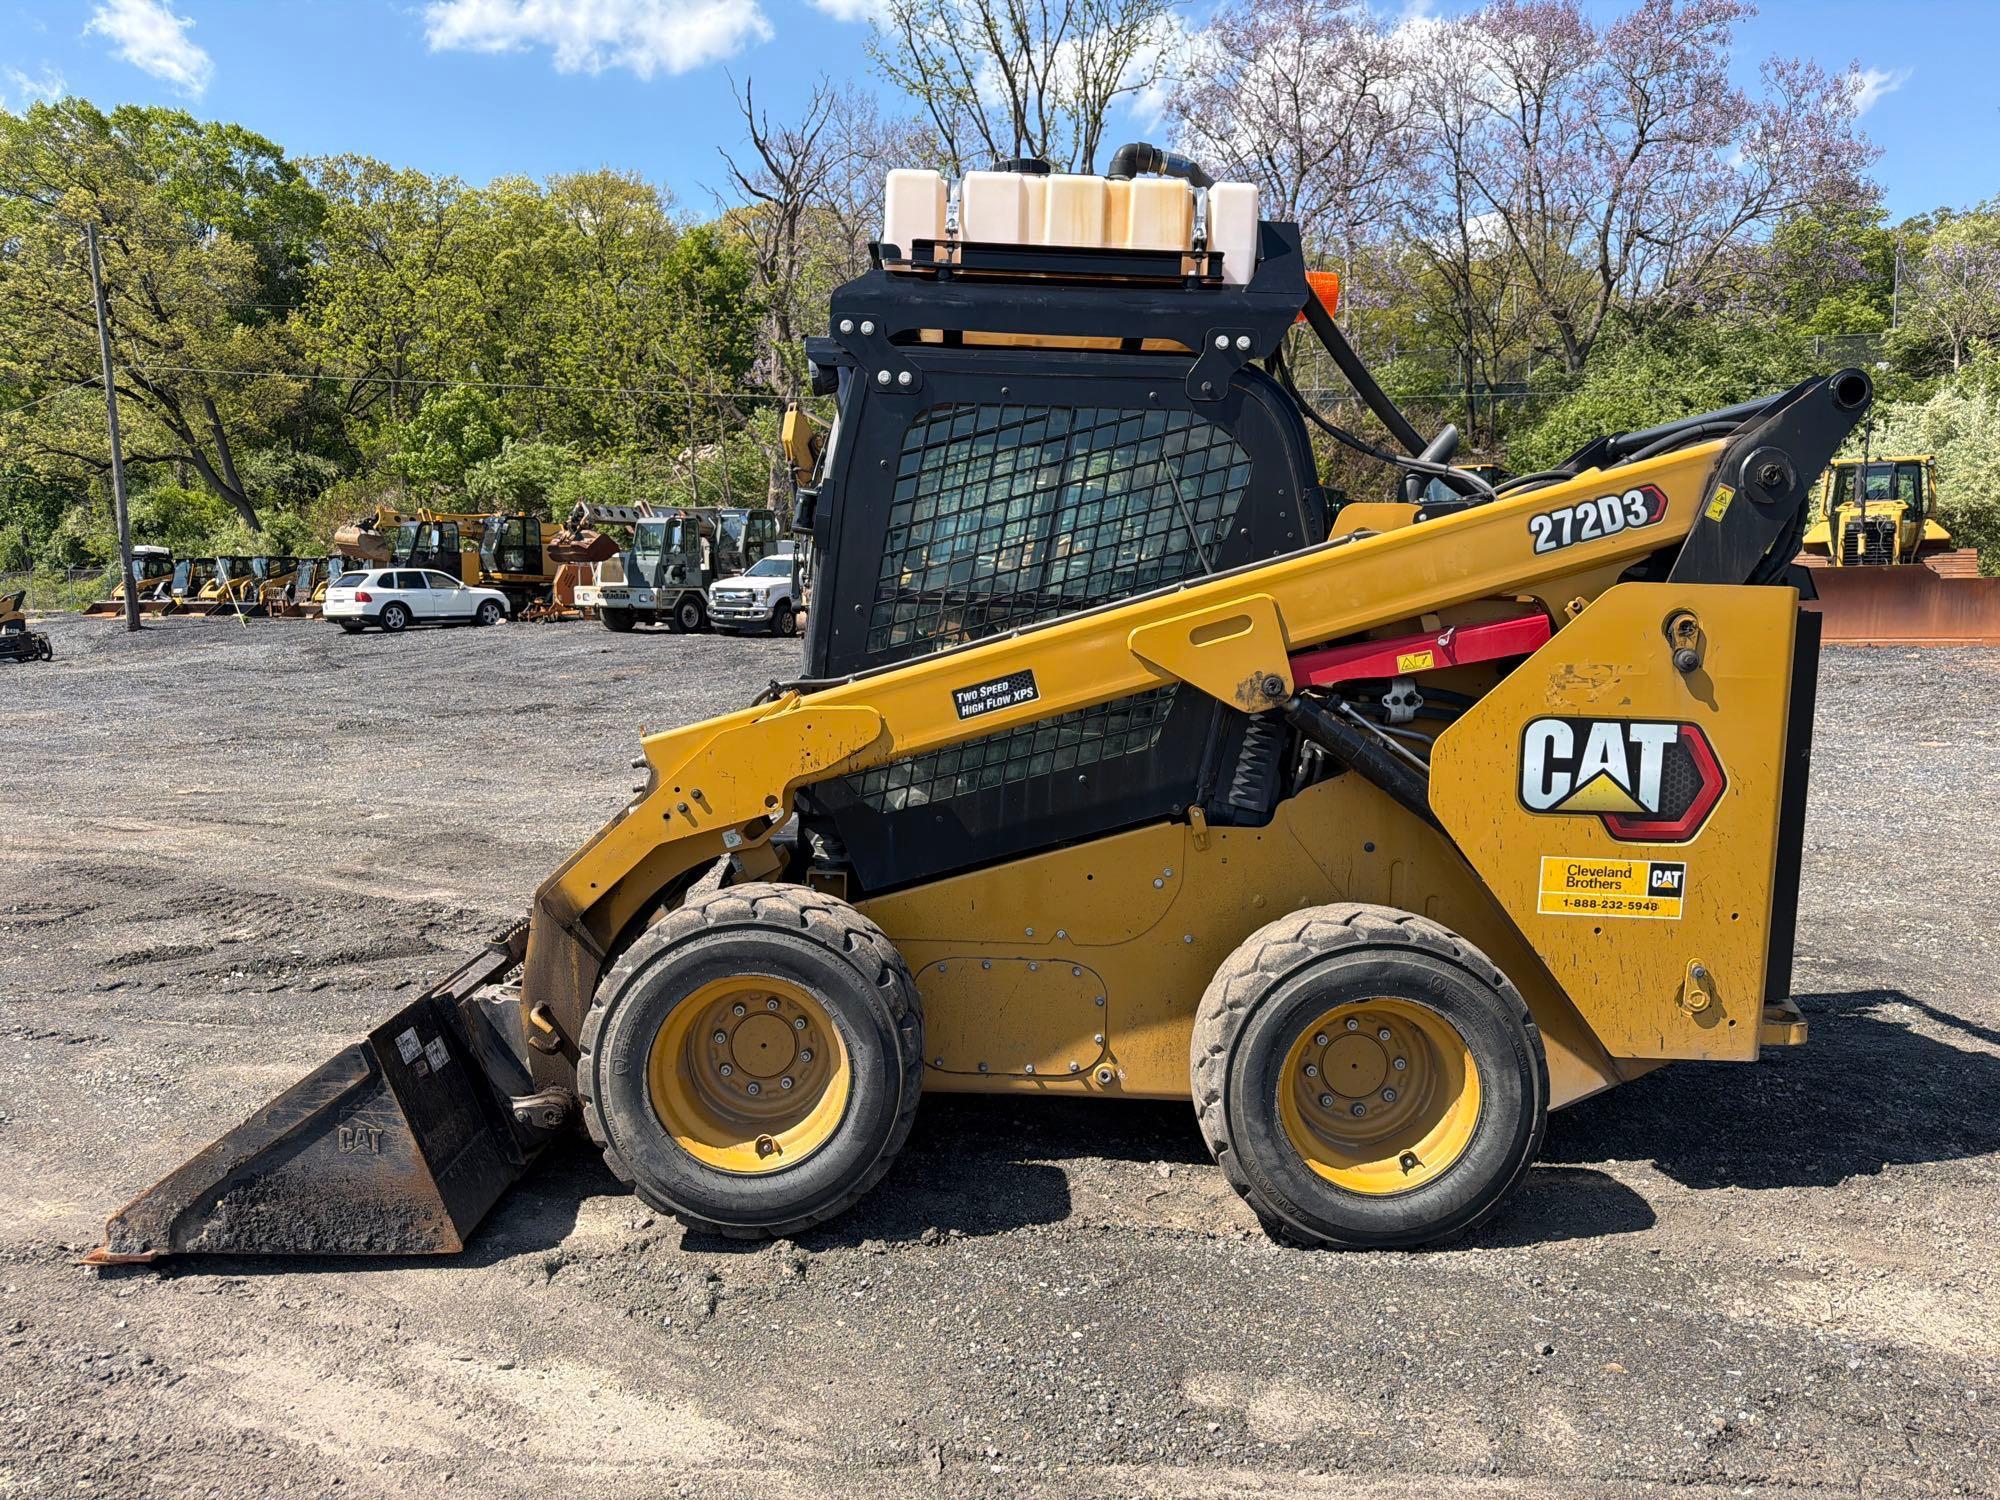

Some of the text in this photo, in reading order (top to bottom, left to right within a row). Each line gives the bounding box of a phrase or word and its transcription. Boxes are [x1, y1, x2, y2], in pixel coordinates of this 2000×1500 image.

[1530, 490, 1649, 553] 272D3
[1013, 687, 1033, 701] XPS
[1522, 719, 1678, 813] CAT
[1567, 864, 1632, 878] Cleveland
[1652, 870, 1682, 888] CAT
[1566, 876, 1622, 890] Brothers
[1563, 899, 1658, 911] 1-888-232-5948
[338, 1127, 383, 1154] CAT
